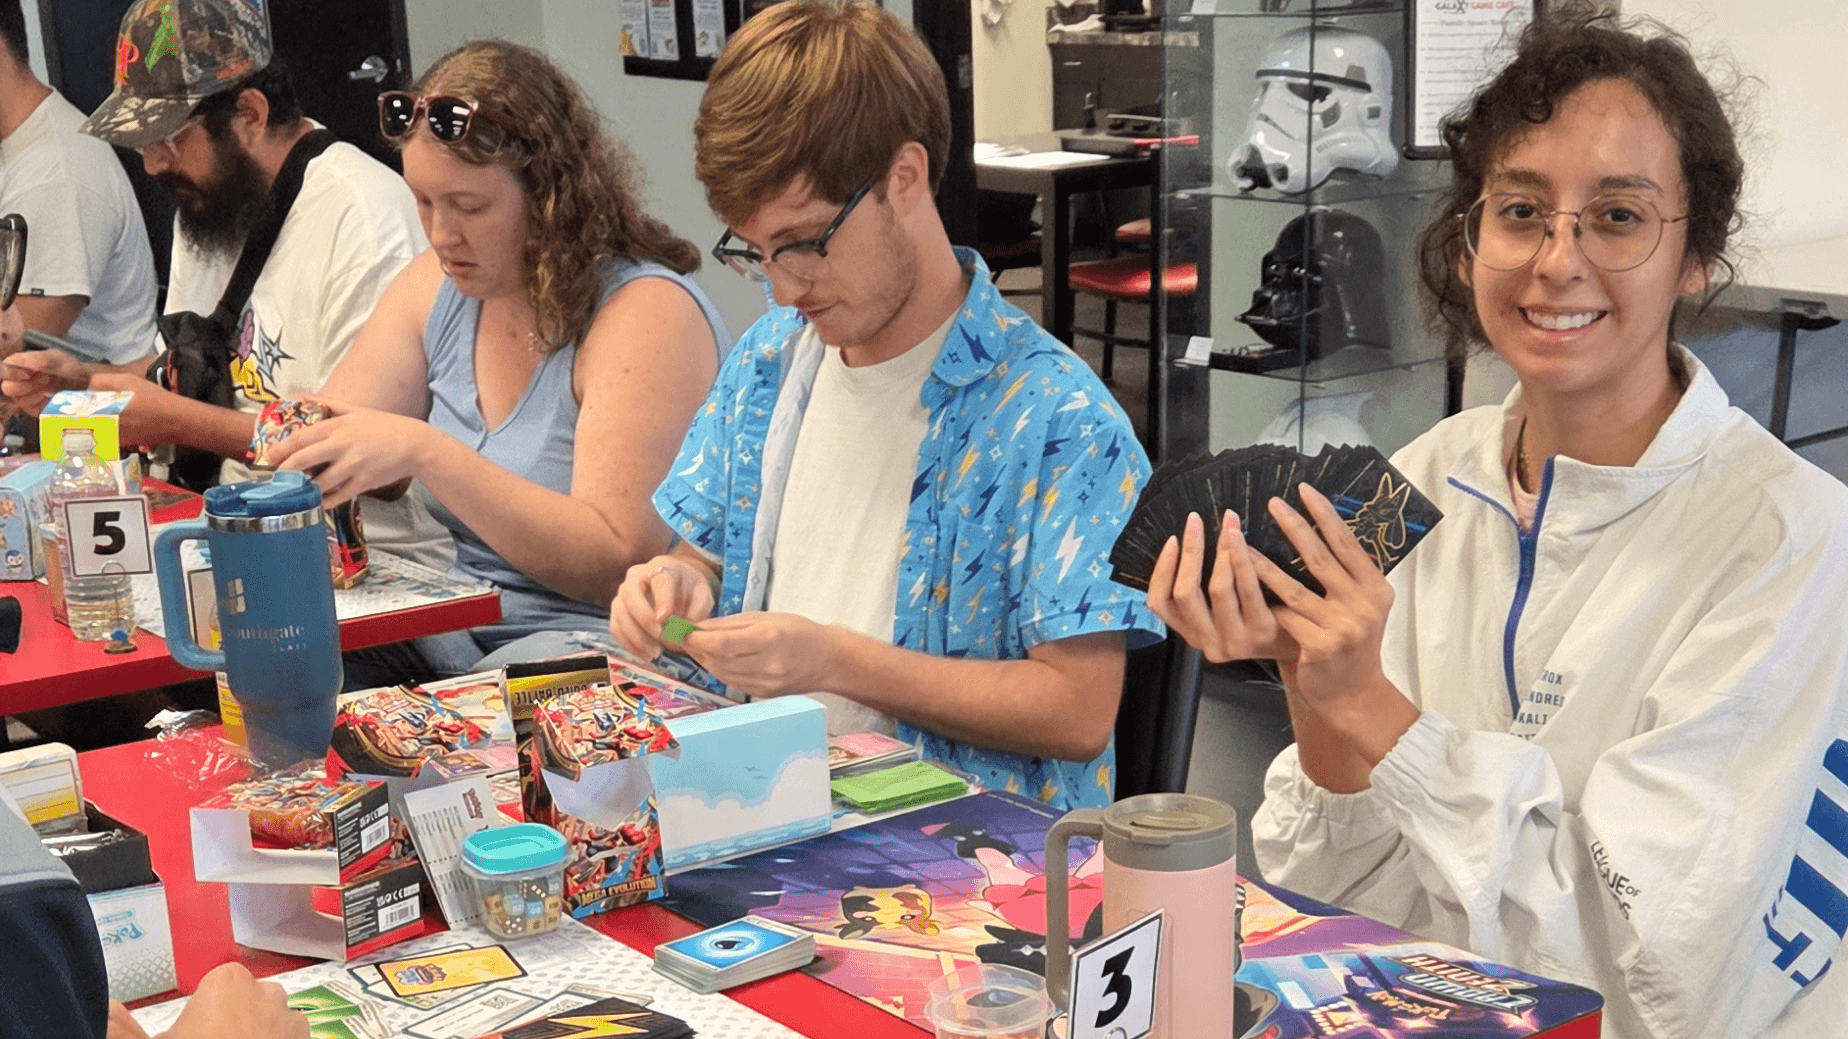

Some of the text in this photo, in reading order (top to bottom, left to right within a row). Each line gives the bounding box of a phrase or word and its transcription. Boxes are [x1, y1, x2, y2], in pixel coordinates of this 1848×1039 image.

[92, 511, 126, 556] 5
[608, 876, 657, 896] EVOLUTION
[1094, 945, 1135, 1028] 3
